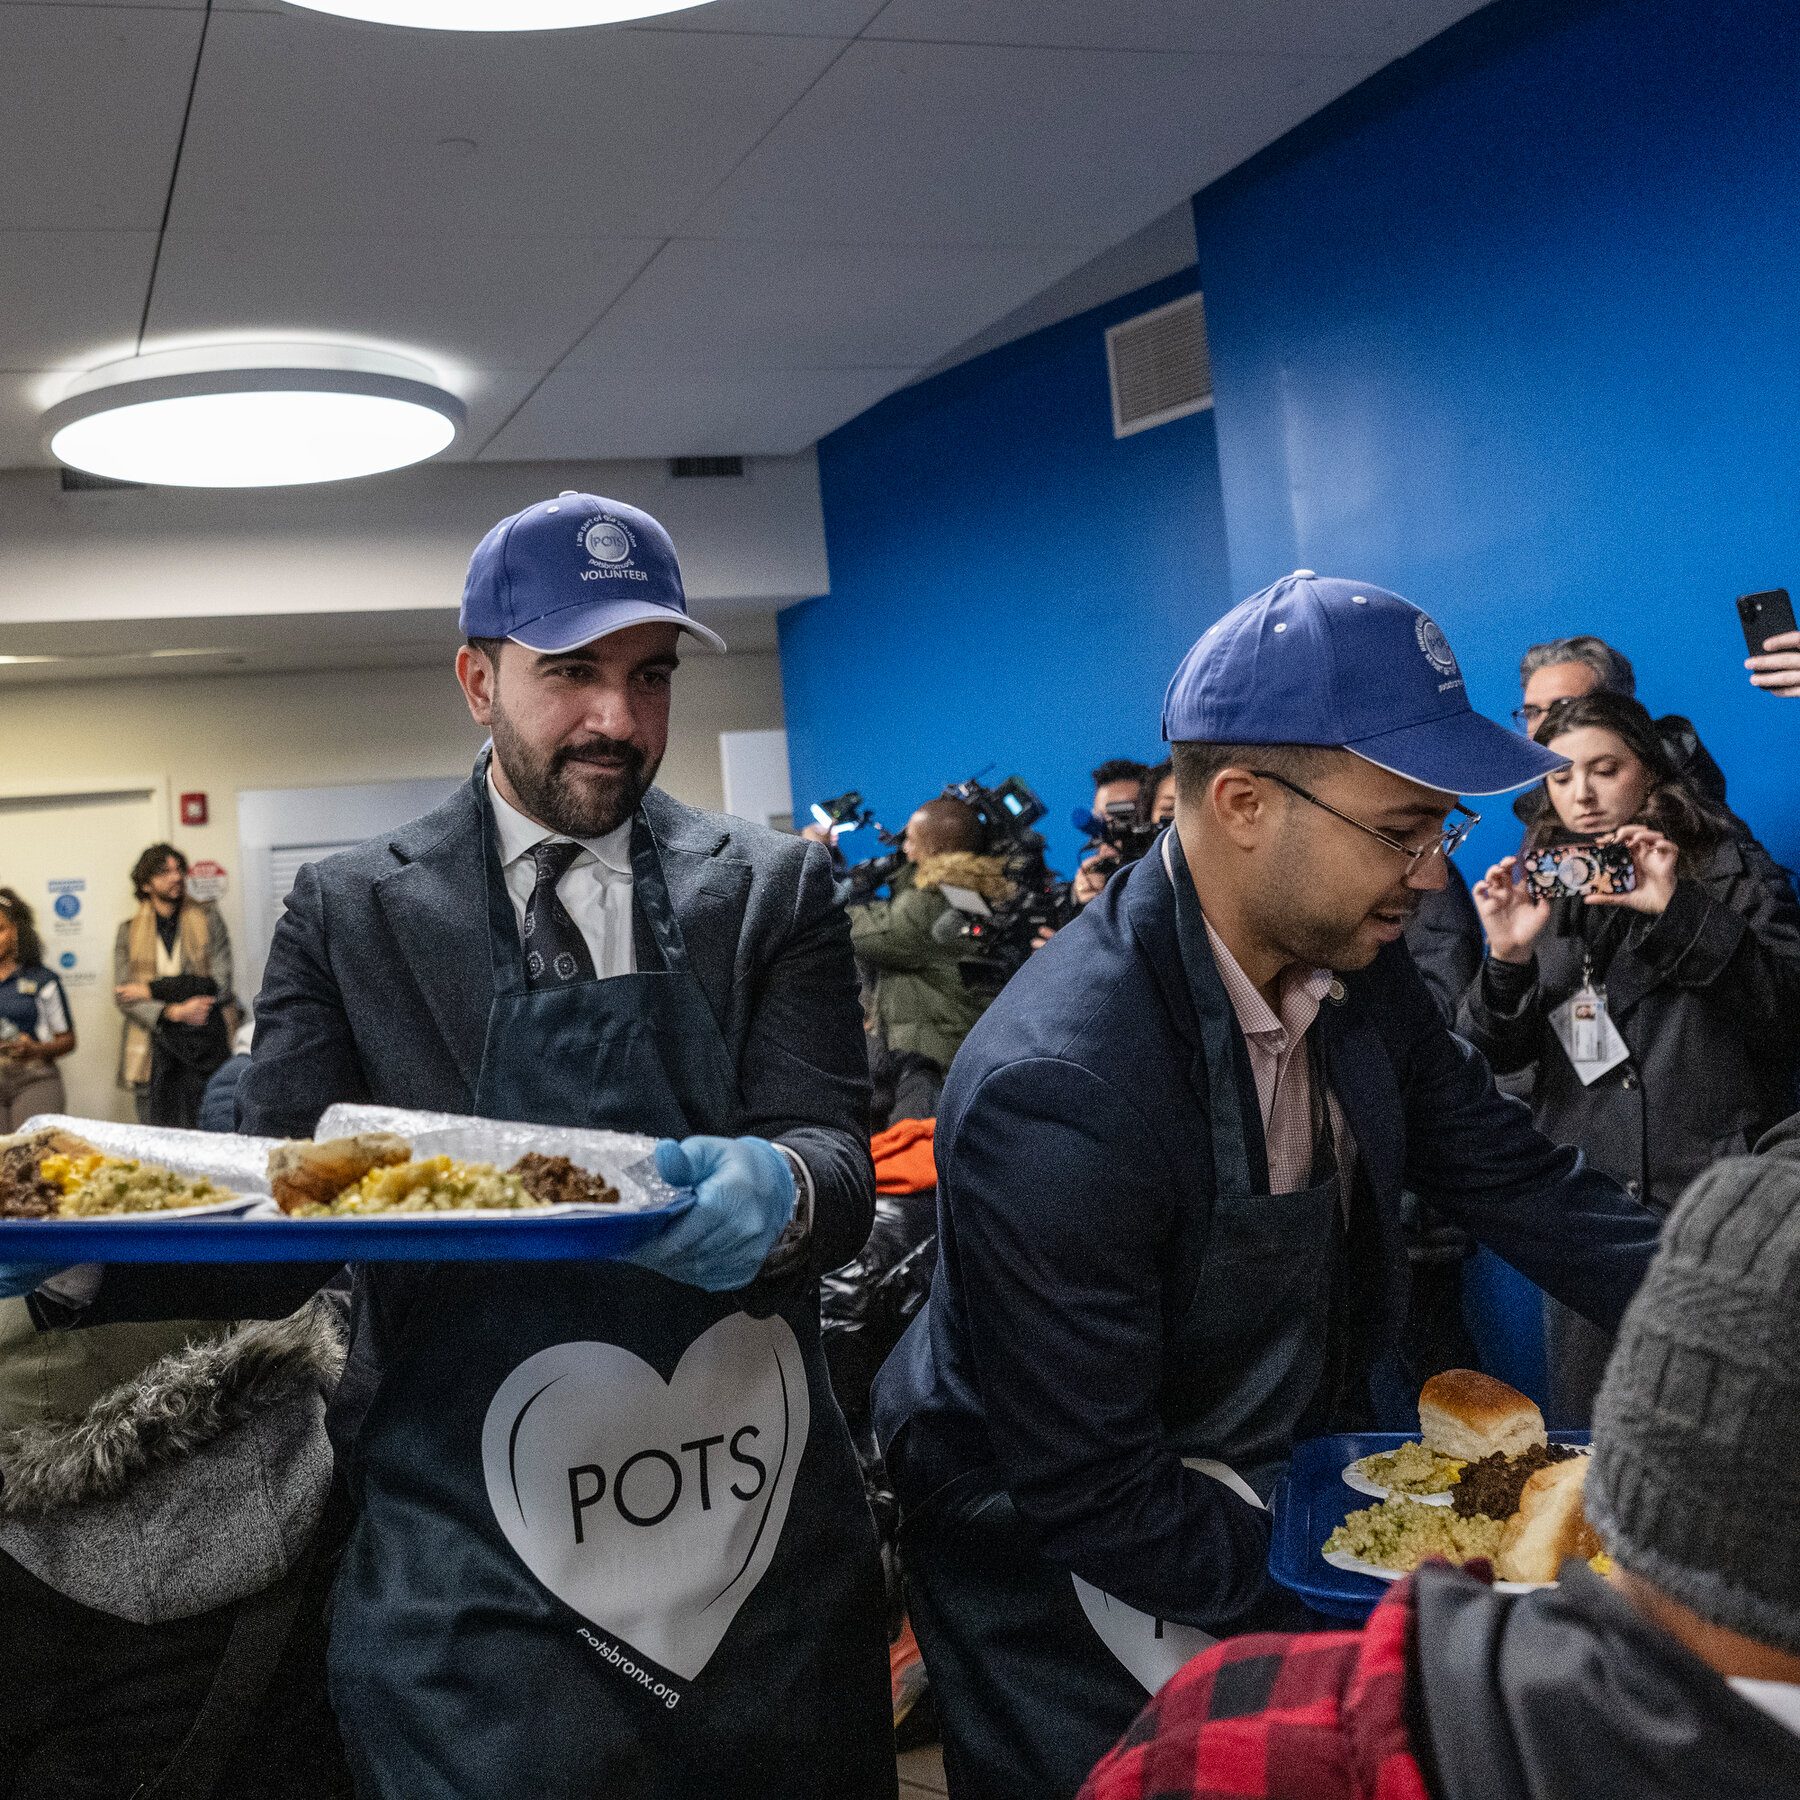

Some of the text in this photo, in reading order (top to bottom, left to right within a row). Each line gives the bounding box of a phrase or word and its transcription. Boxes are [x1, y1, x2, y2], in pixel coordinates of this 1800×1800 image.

[580, 518, 594, 532] part
[593, 514, 602, 522] of
[617, 520, 637, 547] solution
[594, 536, 624, 548] POTS
[580, 569, 649, 581] VOLUNTEER
[567, 1425, 767, 1545] POTS
[576, 1627, 681, 1709] potsbronx.org
